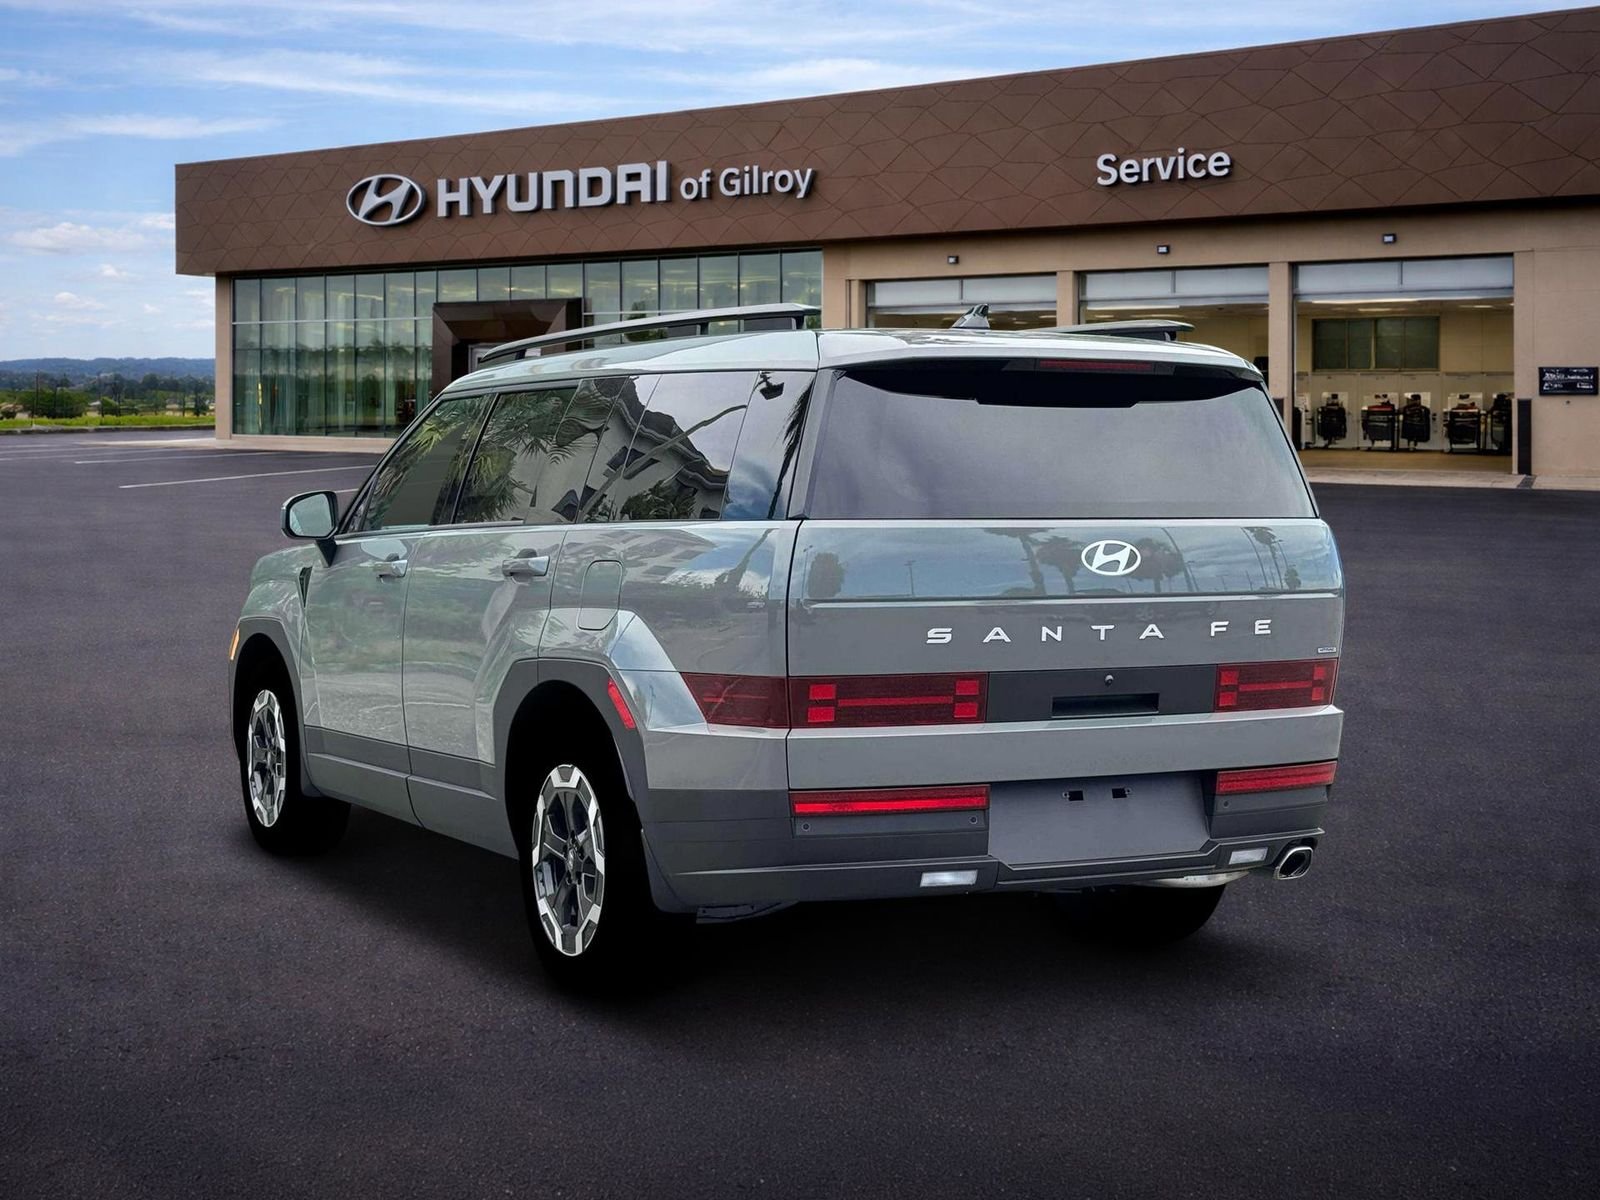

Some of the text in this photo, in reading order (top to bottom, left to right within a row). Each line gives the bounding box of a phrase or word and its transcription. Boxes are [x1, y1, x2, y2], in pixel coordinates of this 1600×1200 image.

[1096, 147, 1231, 186] Service
[437, 160, 813, 217] HYUNDAI of Gilroy
[926, 619, 1273, 644] SANTA FE
